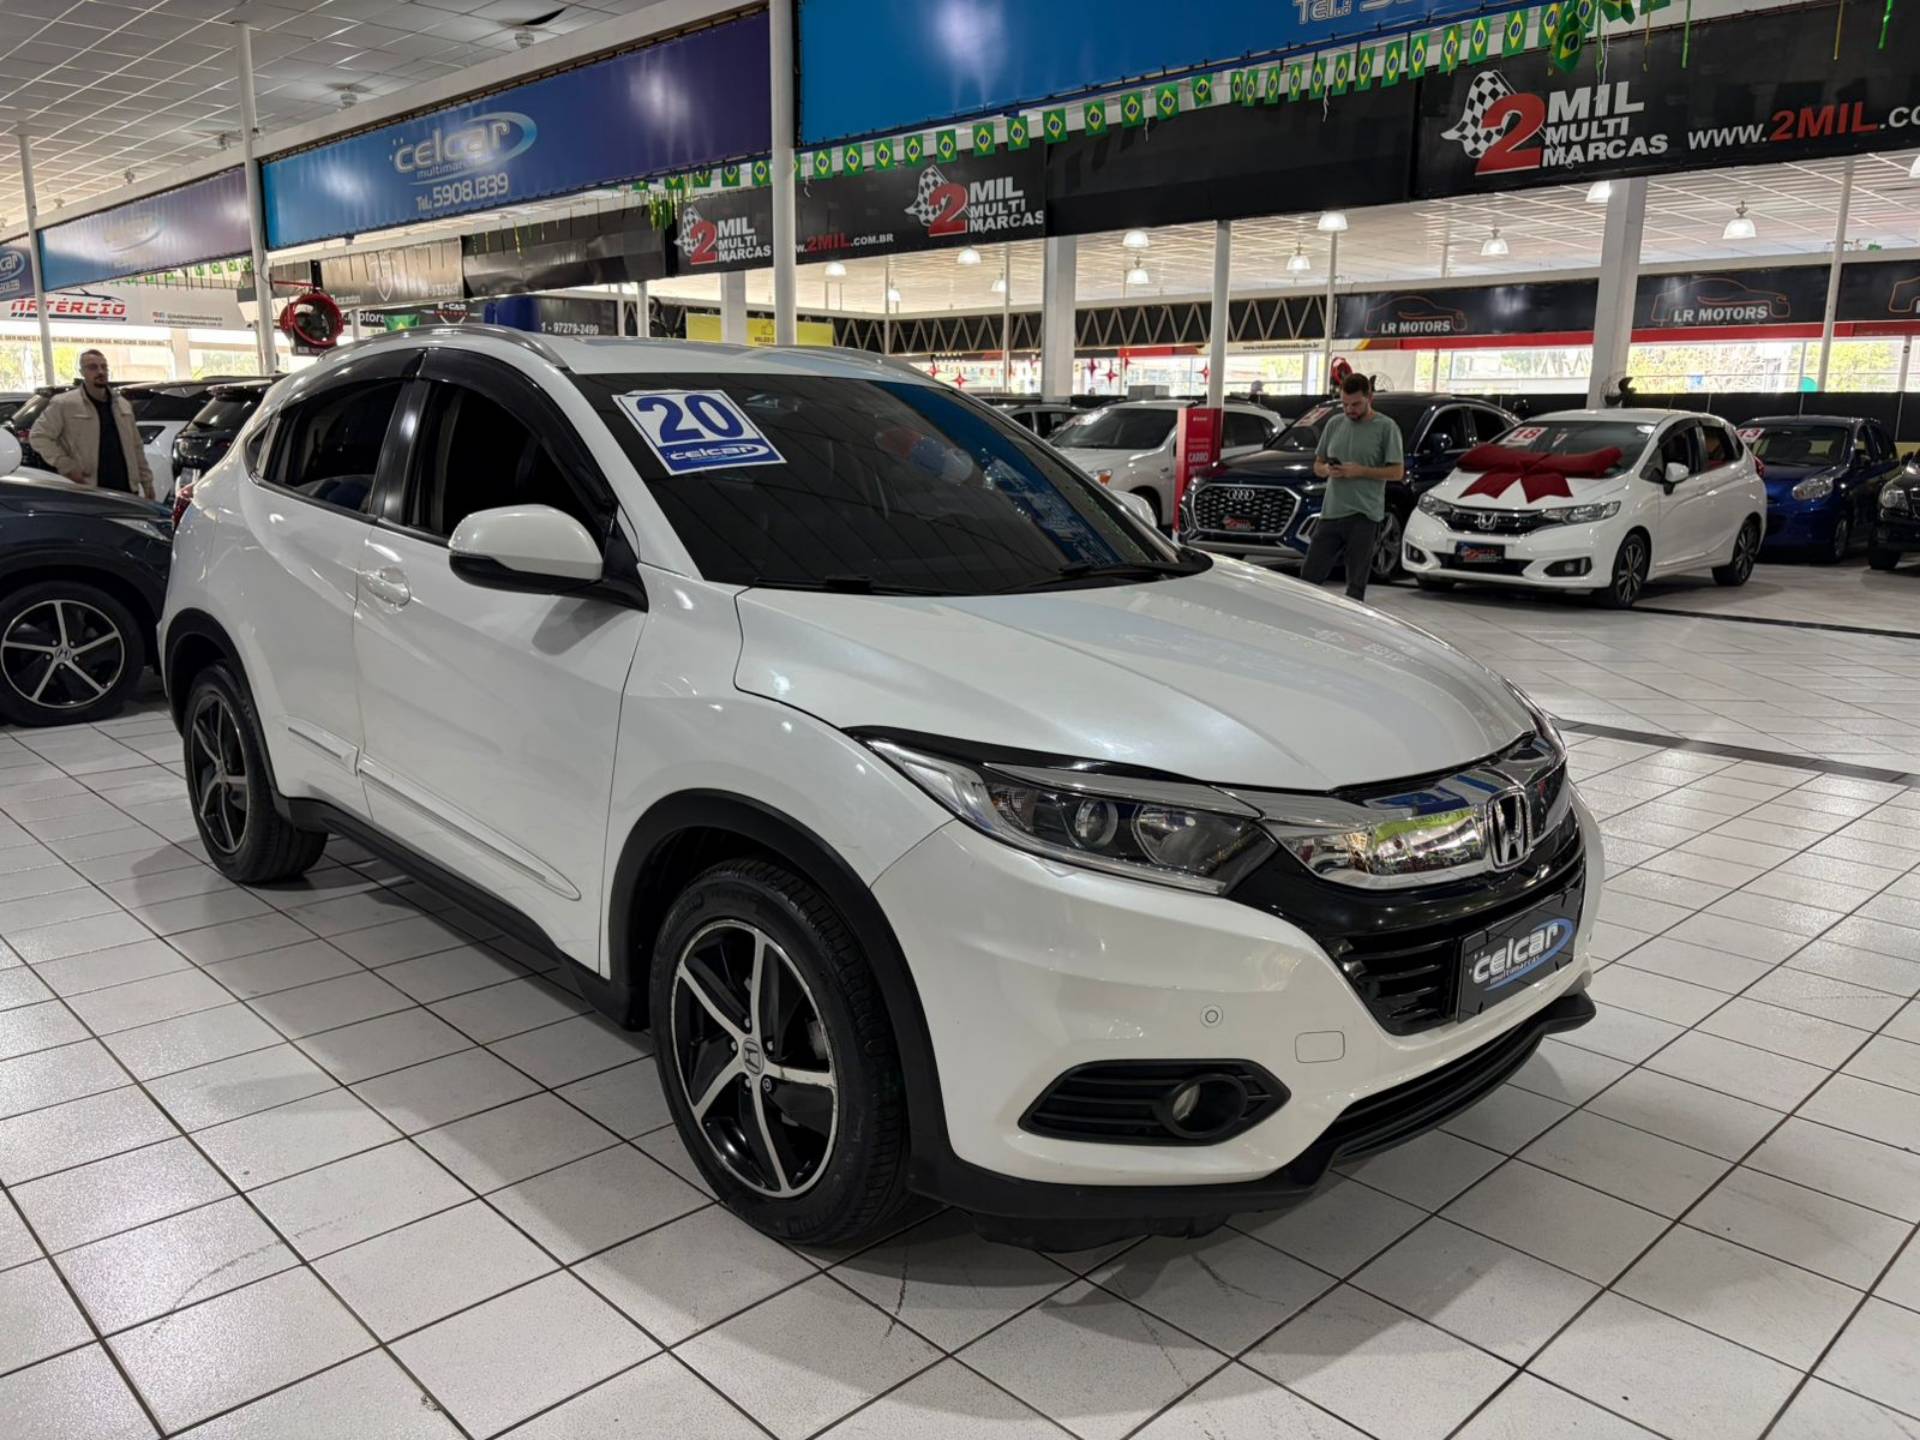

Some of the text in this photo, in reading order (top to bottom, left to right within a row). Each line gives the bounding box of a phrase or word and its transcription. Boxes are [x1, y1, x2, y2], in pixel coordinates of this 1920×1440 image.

[1475, 81, 1645, 175] 2 MIL
[1545, 116, 1630, 147] MULTI
[394, 121, 510, 173] celcar
[1542, 134, 1669, 168] MARCAS
[928, 176, 1024, 237] 2 MIL
[969, 211, 1044, 233] MARCAS
[970, 199, 1026, 219] MULTI
[690, 217, 755, 265] 2 MIL
[718, 235, 757, 249] MULTI
[719, 245, 771, 262] MARCAS
[1381, 320, 1451, 334] LR MOTORS
[1673, 305, 1768, 322] LR MOTORS
[636, 394, 744, 443] 20
[670, 445, 754, 461] celcar
[1473, 922, 1559, 984] celcar
